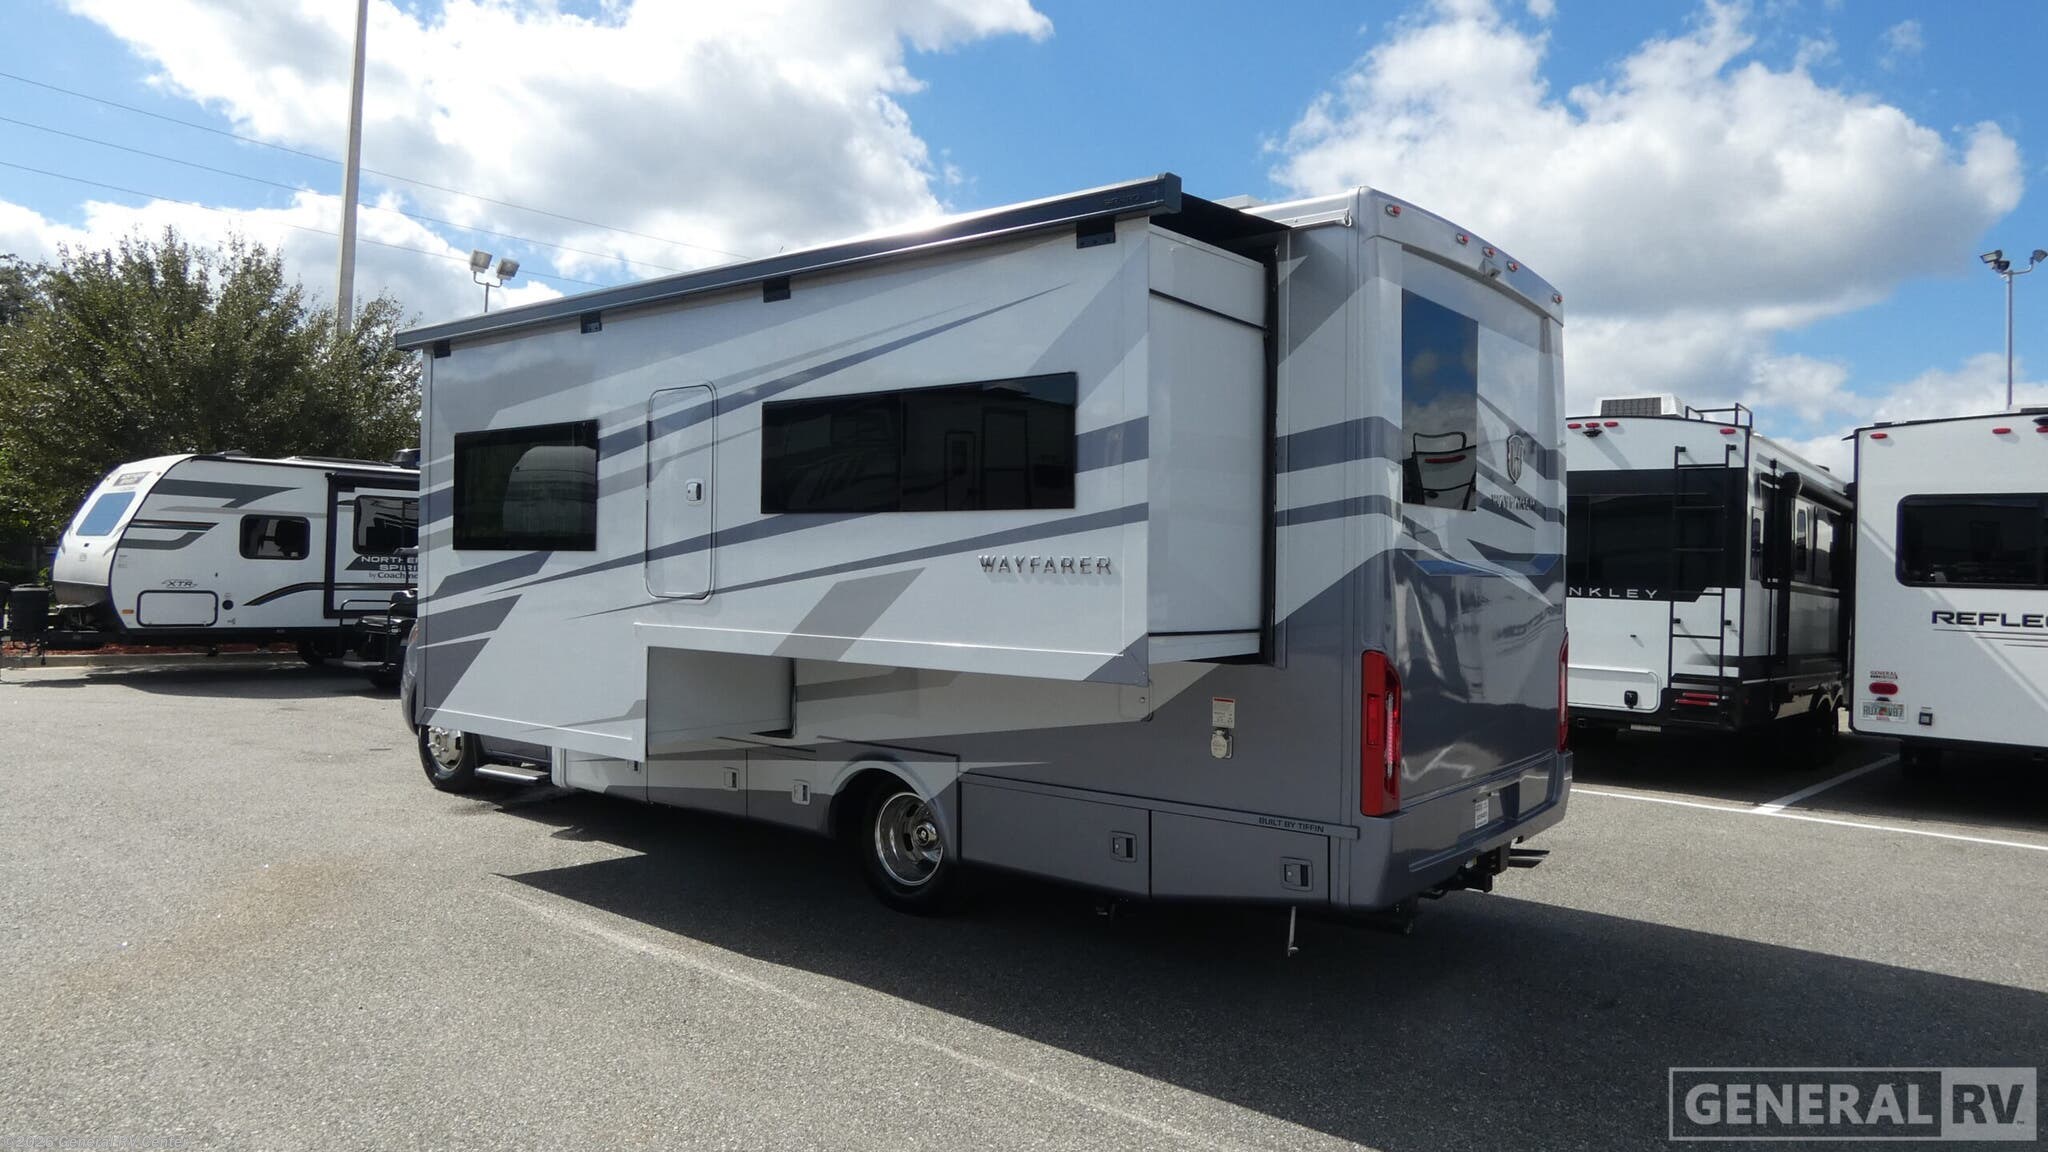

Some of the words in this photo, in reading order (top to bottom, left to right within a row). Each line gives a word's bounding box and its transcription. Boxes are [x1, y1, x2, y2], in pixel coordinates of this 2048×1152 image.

[361, 556, 418, 564] NORTHE
[978, 555, 1112, 575] WAYFARER
[1931, 610, 2048, 628] REFLE
[1258, 816, 1282, 826] BUILT
[1284, 820, 1296, 829] BY
[1297, 822, 1325, 833] TIFFIN
